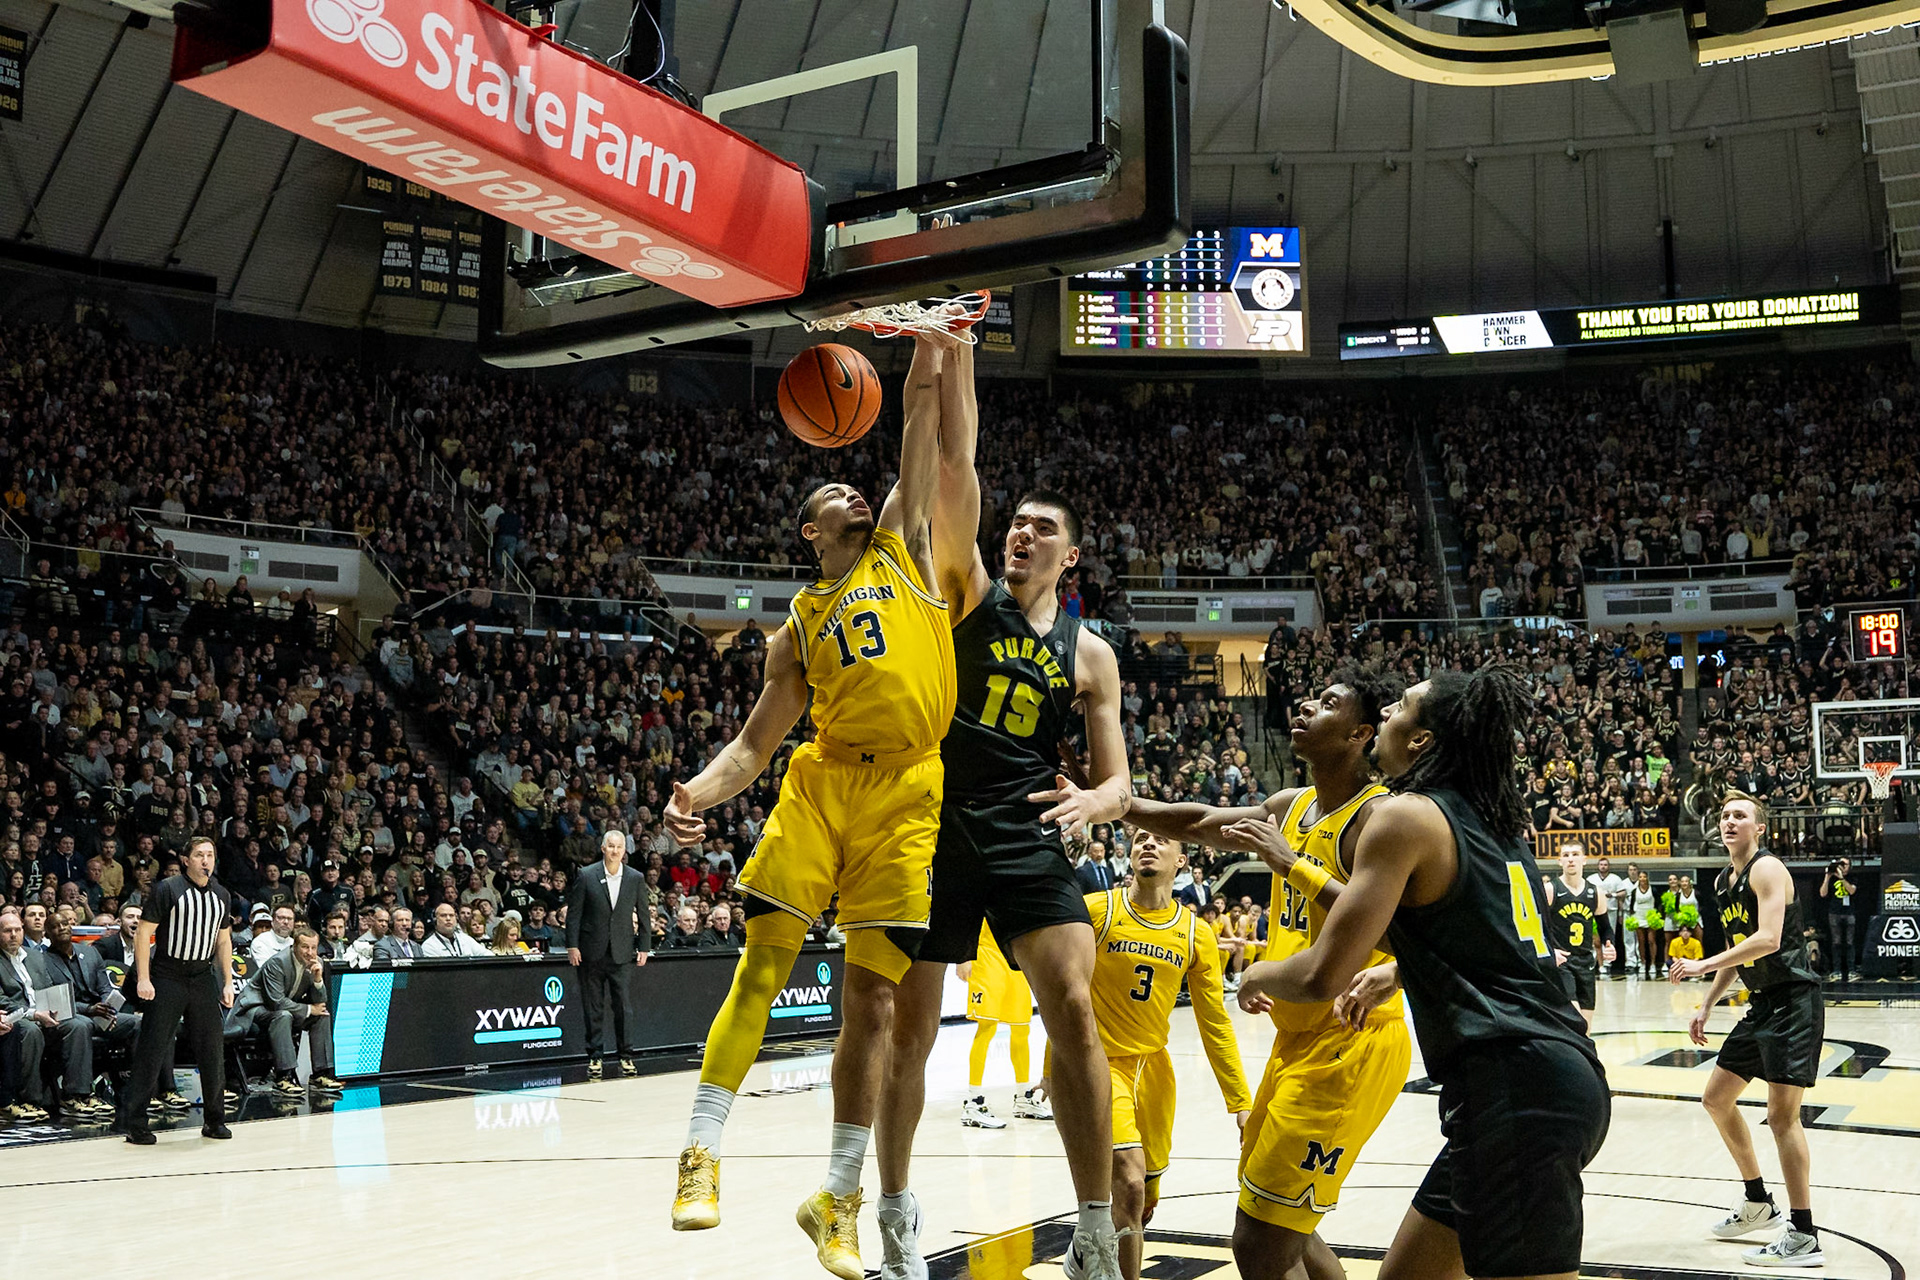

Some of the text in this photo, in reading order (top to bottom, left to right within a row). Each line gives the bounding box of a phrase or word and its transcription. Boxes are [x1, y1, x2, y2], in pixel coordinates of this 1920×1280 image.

[367, 176, 392, 192] 1935
[383, 221, 414, 233] PURDUE
[420, 226, 452, 239] PURDUE
[458, 231, 482, 243] PURD
[386, 241, 409, 250] MEN'S
[424, 246, 446, 256] MEN'S
[1250, 233, 1284, 258] M
[384, 250, 411, 260] BIG TEN
[422, 254, 449, 266] BIG TEN
[462, 252, 480, 262] MEN'
[382, 258, 412, 268] CHAMPS
[420, 262, 450, 274] CHAMPS
[459, 260, 480, 270] BIG TE
[382, 274, 411, 288] 1979
[421, 280, 448, 294] 1984
[1578, 292, 1859, 328] THANK YOU FOR YOUR DONATION!
[1483, 316, 1526, 326] HAMMER
[1581, 311, 1859, 340] ALL PROCEEDS GO TOWARDS THE PURDUE INSTITUTE FOR CANCER RESEARCH
[985, 331, 1012, 344] 2023
[1246, 318, 1292, 344] P
[1484, 326, 1510, 336] DWN
[1484, 334, 1526, 347] CNCER
[819, 584, 896, 642] MICHIGAN
[1860, 614, 1898, 630] 18:00
[833, 610, 887, 670] 13
[1870, 630, 1896, 656] 19
[989, 637, 1069, 689] PURDUE
[980, 674, 1045, 738] 15
[861, 752, 875, 764] M
[1537, 832, 1666, 857] DENSE LIVES 0 6
[1613, 842, 1640, 856] HERE
[516, 896, 526, 906] 15
[1506, 861, 1551, 958] 4
[1558, 902, 1594, 920] PURDUE
[1569, 922, 1584, 946] 3
[1106, 940, 1184, 969] MICHIGAN
[1130, 964, 1155, 1002] 3
[771, 986, 831, 1006] XYWAY
[972, 992, 982, 1004] M
[475, 1006, 562, 1030] XYWAY
[523, 1040, 562, 1049] FUNGICIDES
[1300, 1140, 1346, 1176] M
